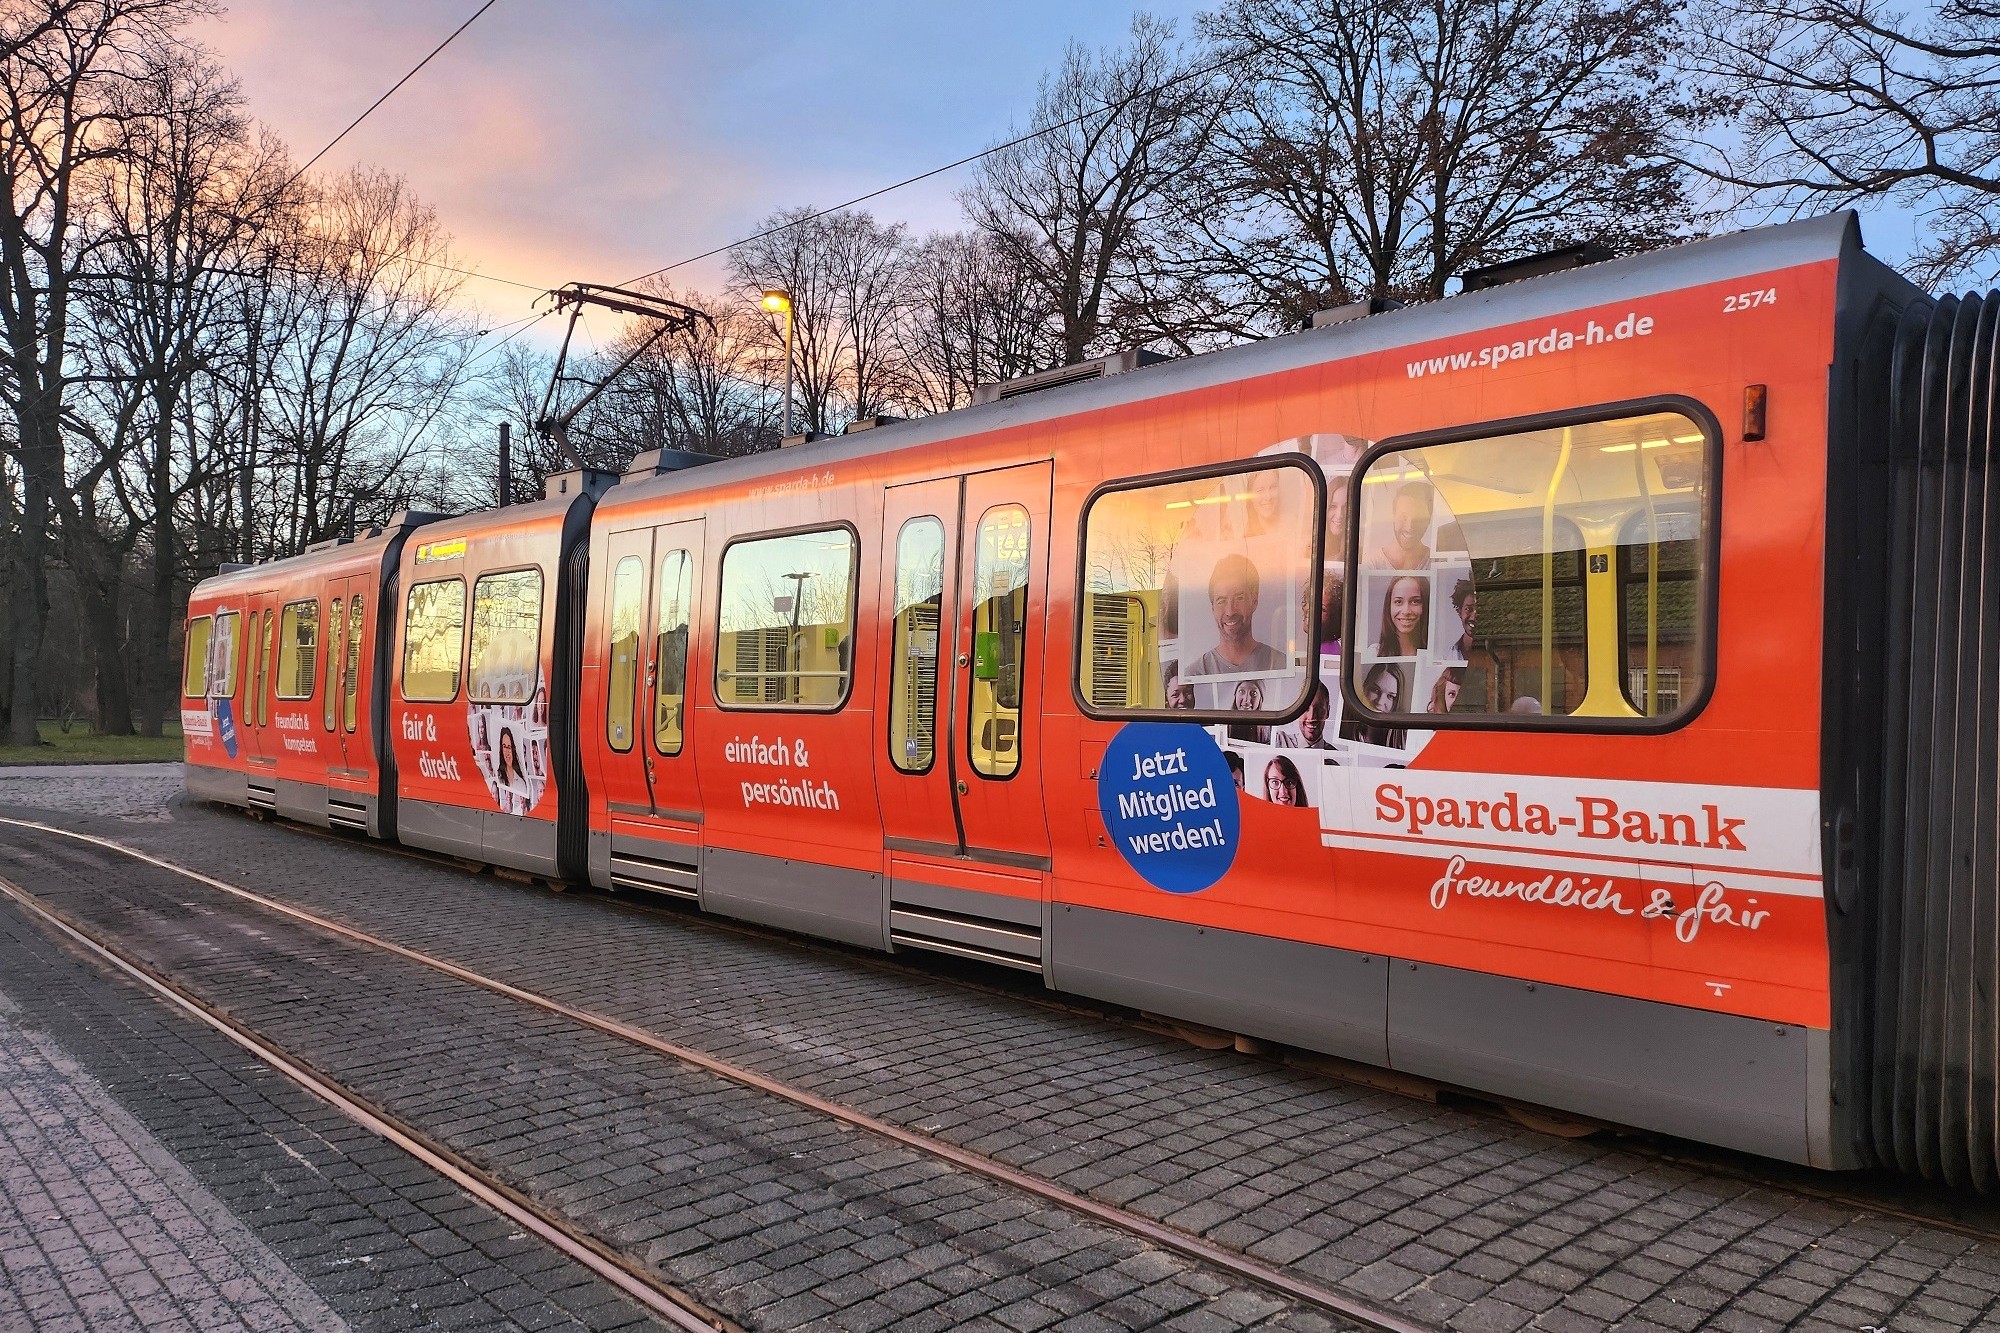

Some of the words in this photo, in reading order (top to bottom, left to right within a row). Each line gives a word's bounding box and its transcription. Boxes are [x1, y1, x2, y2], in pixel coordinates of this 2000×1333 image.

[1723, 287, 1777, 314] 2574
[1406, 312, 1655, 380] www.sparda-h.de
[748, 470, 835, 498] www.sparda-h.de
[304, 713, 310, 730] &
[402, 711, 424, 740] fair
[426, 714, 437, 742] &
[419, 750, 461, 781] direkt
[725, 735, 790, 766] einfach
[794, 738, 810, 767] &
[1132, 747, 1188, 780] Jetzt
[741, 778, 840, 811] persönlich
[1118, 778, 1217, 821] Mitglied
[1374, 783, 1747, 852] Sparda-Bank
[1128, 818, 1226, 854] werden!
[1430, 855, 1635, 910] freundlich
[1641, 888, 1677, 920] &
[1675, 881, 1771, 943] fair
